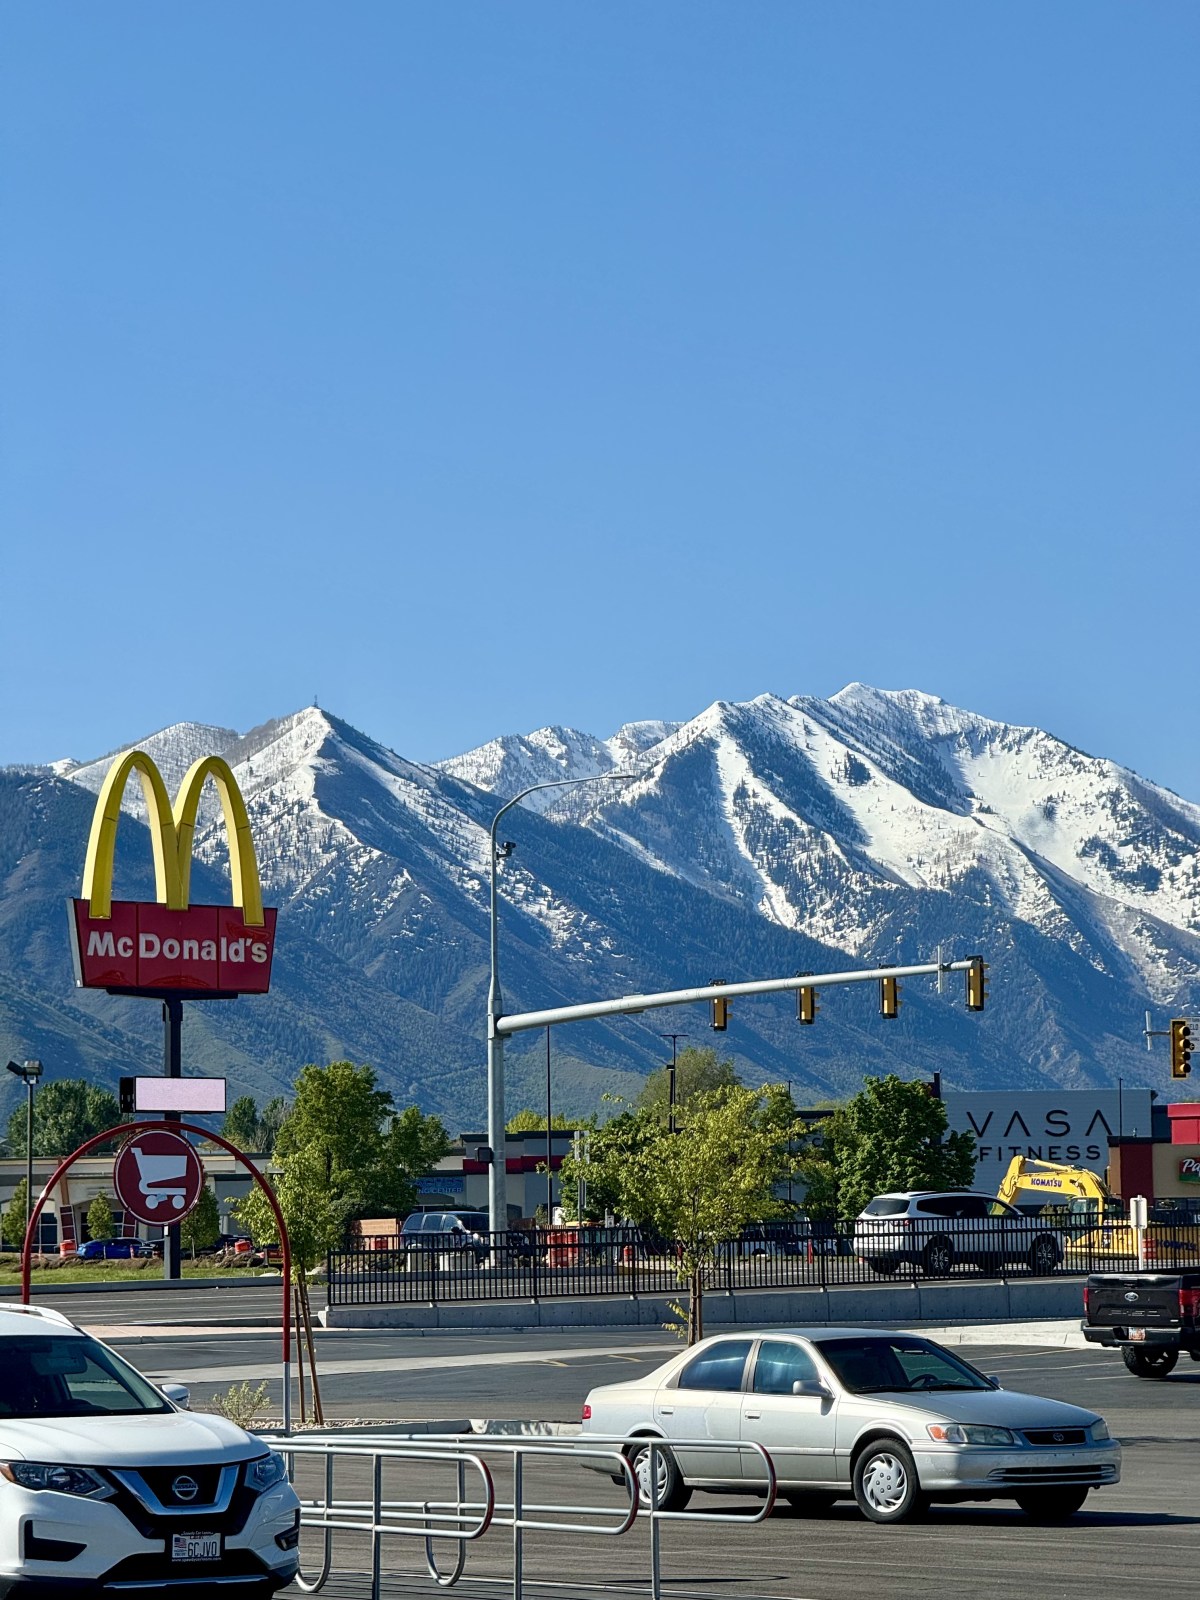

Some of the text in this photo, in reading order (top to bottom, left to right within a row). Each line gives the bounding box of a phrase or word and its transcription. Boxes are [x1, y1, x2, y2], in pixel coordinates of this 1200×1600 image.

[87, 930, 269, 963] McDonald's
[966, 1109, 1112, 1138] VASA
[979, 1145, 1101, 1161] FITNESS
[1031, 1178, 1063, 1188] KOMATSU
